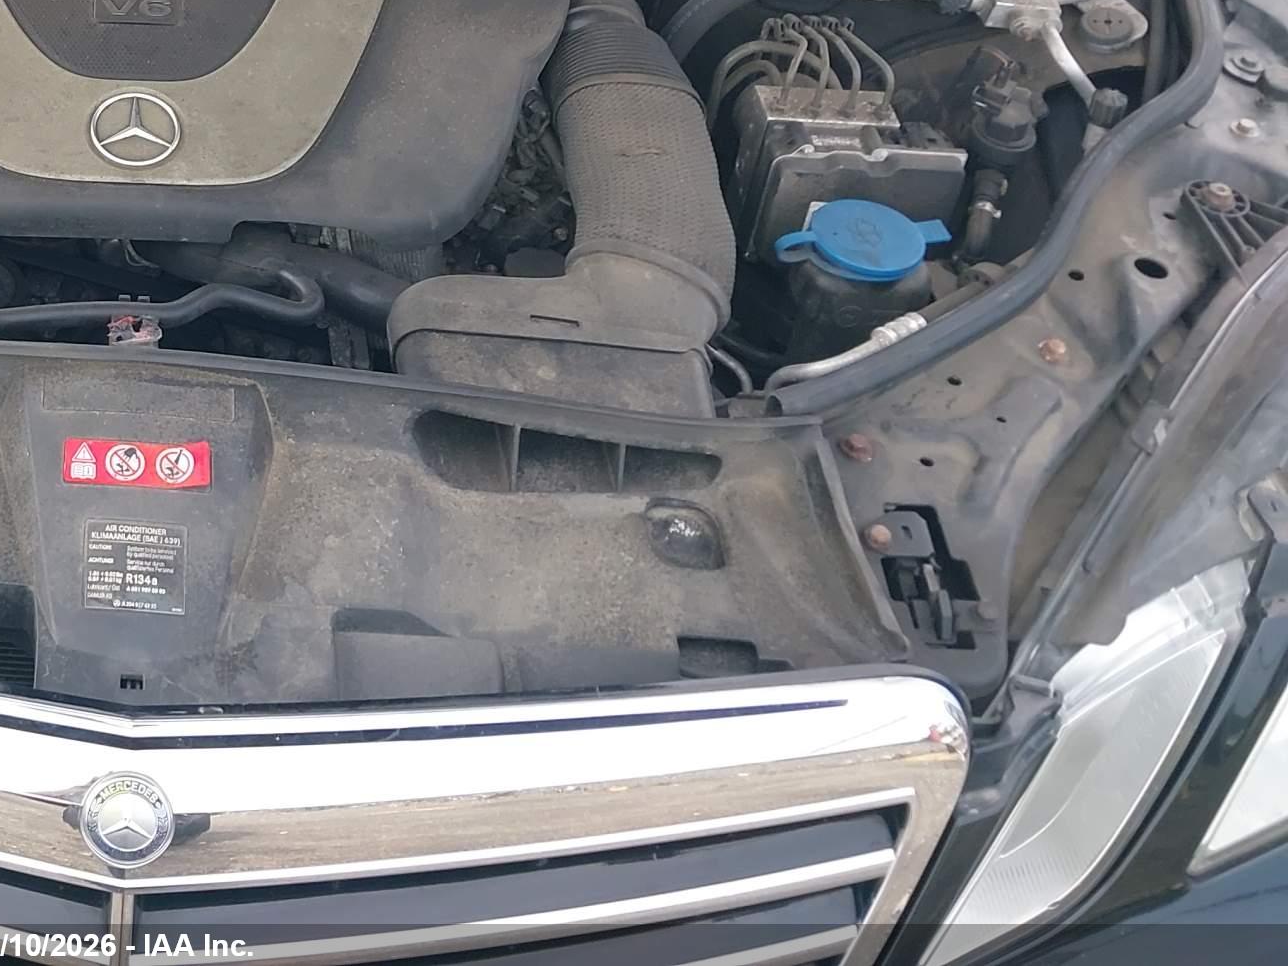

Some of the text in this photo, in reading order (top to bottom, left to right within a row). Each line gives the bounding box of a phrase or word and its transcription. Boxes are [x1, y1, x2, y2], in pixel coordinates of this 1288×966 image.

[91, 531, 141, 541] KLIMAANLAGE
[105, 524, 167, 536] AIR CONDITIONER
[100, 780, 159, 803] MERCEDES
